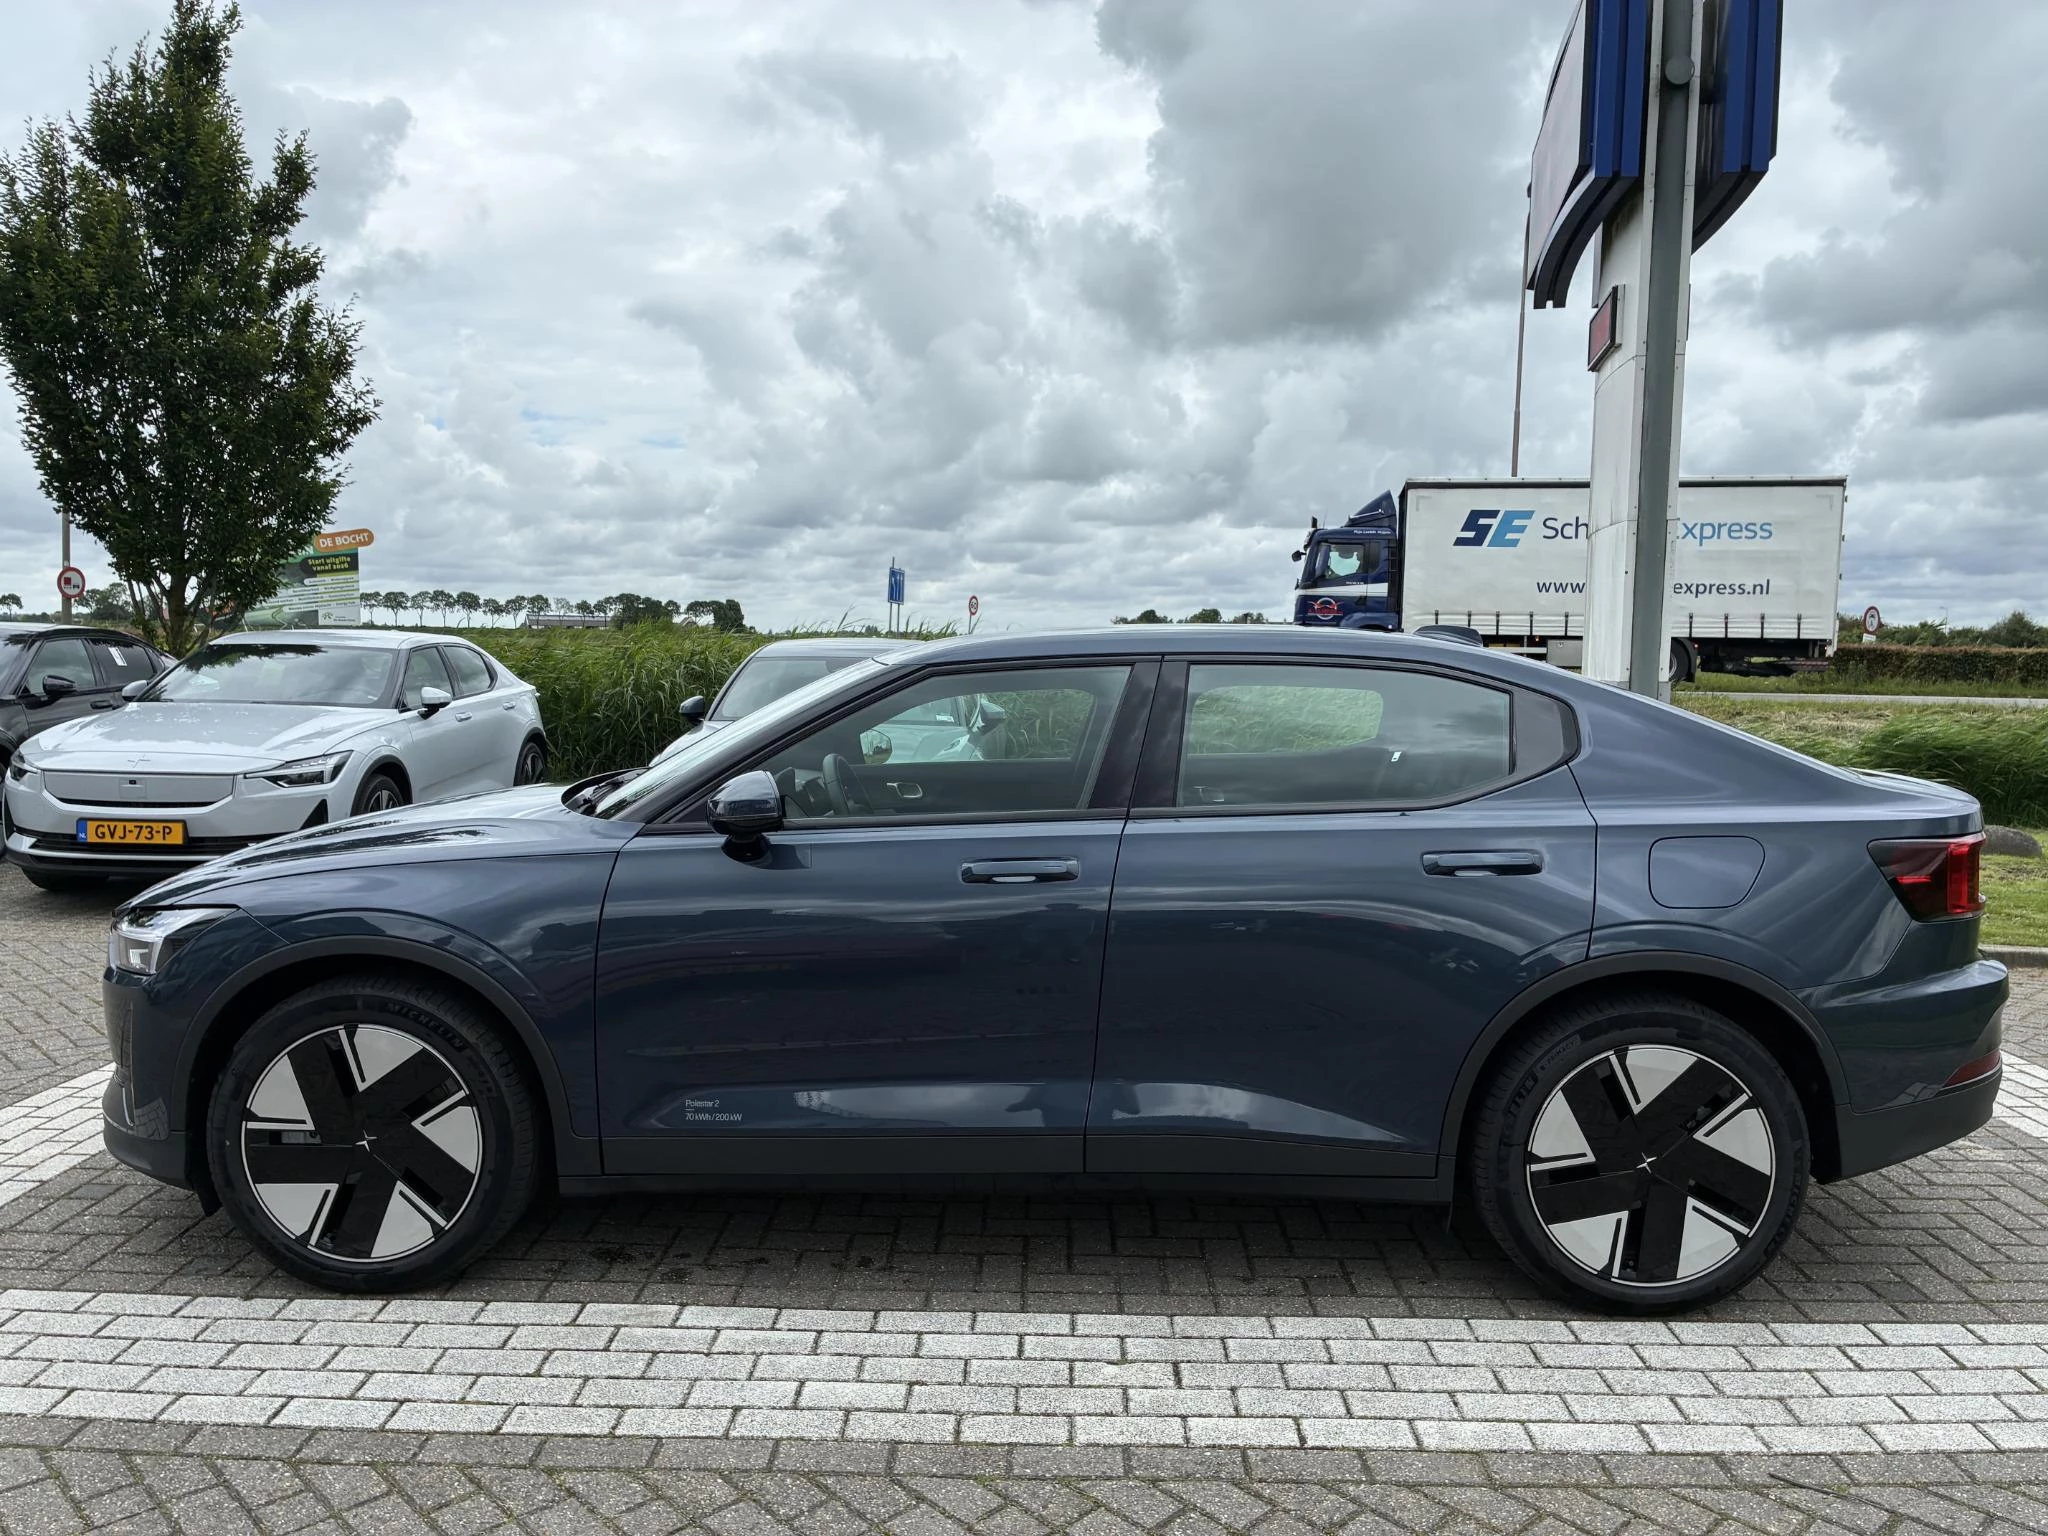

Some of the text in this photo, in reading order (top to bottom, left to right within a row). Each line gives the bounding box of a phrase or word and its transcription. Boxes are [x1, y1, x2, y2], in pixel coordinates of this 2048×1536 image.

[1453, 509, 1773, 548] SE Sch xpress
[319, 532, 370, 548] DE BOCHT
[308, 556, 351, 566] Start uitgifte
[94, 824, 173, 841] GVJ-73-P
